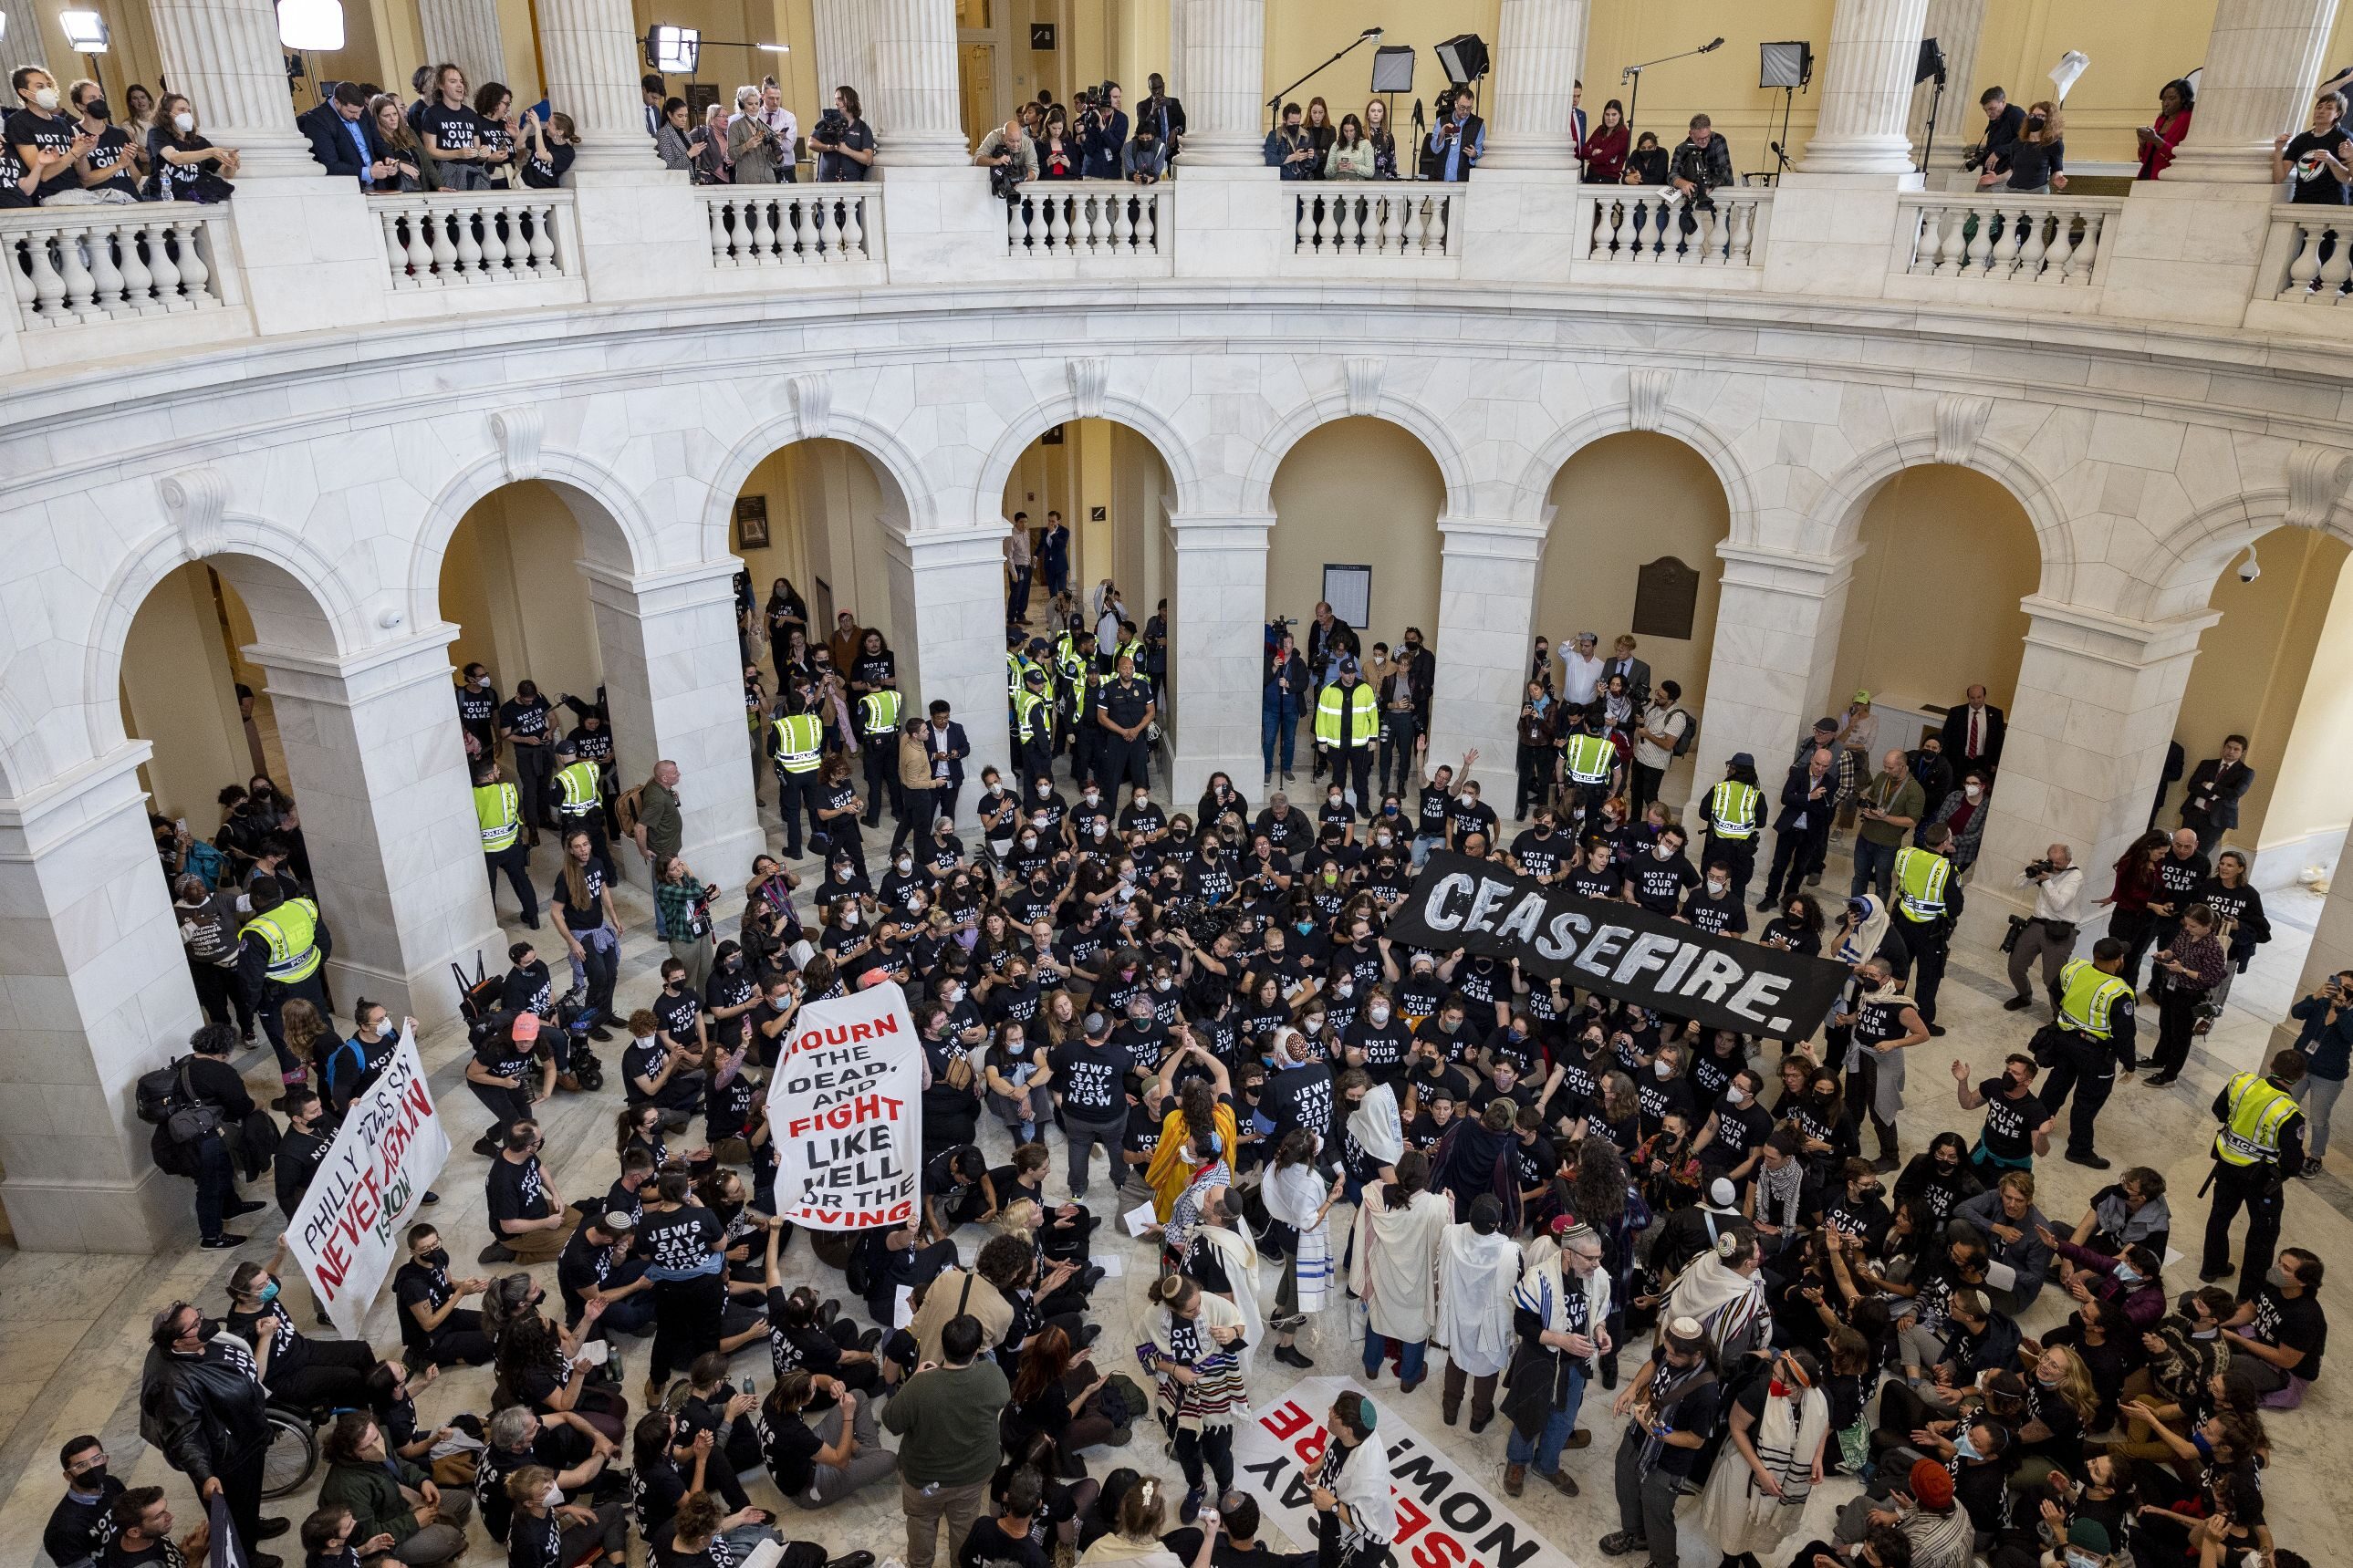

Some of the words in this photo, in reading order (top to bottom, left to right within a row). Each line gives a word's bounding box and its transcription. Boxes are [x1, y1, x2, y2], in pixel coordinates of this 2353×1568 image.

[35, 134, 59, 142] NOT
[448, 130, 472, 139] OUR
[517, 712, 532, 721] NOT
[835, 797, 852, 808] OUR
[1423, 808, 1443, 817] NAME
[1718, 821, 1745, 830] POLICE
[1526, 859, 1548, 868] OUR
[1206, 879, 1226, 887] OUR
[1648, 879, 1671, 887] OUR
[2162, 873, 2189, 884] OUR
[1202, 885, 1232, 894] NAME
[1577, 881, 1596, 889] NOT
[1643, 886, 1674, 895] NAME
[2207, 895, 2230, 904] NOT
[2210, 903, 2239, 915] OUR
[1699, 917, 1722, 927] OUR
[1074, 942, 1091, 951] NOT
[1425, 872, 1792, 1032] CEASEFIRE.
[992, 950, 1006, 960] NOT
[1461, 985, 1493, 1002] NAME
[1468, 982, 1489, 993] OUR
[1408, 1002, 1431, 1010] OUR
[1531, 999, 1551, 1011] OUR
[669, 1005, 687, 1020] NOT
[1013, 1006, 1035, 1018] OUR
[1158, 1007, 1174, 1020] OUR
[1875, 1010, 1886, 1018] IN
[1328, 1015, 1351, 1024] OUR
[1858, 1012, 1879, 1026] OUR
[809, 1045, 871, 1068] THE
[1136, 1048, 1158, 1058] OUR
[369, 1052, 391, 1069] NOT
[1699, 1058, 1716, 1072] NOT
[1070, 1062, 1112, 1075] JEWS
[1568, 1065, 1587, 1077] NOT
[788, 1062, 898, 1094] DEAD,
[1074, 1073, 1105, 1084] SAY
[1570, 1076, 1595, 1090] OUR
[1294, 1079, 1331, 1101] JEWS
[1416, 1081, 1434, 1094] NOT
[1641, 1085, 1658, 1099] NOT
[813, 1079, 876, 1109] AND
[1068, 1092, 1111, 1106] NOW
[1301, 1092, 1329, 1111] SAY
[1990, 1097, 2008, 1113] NOT
[2010, 1112, 2023, 1123] IN
[789, 1096, 903, 1138] FIGHT
[1589, 1115, 1606, 1129] NOT
[1990, 1109, 2014, 1131] OUR
[1738, 1123, 1747, 1133] IN
[1820, 1126, 1832, 1135] IN
[311, 1139, 331, 1160] NOT
[807, 1124, 892, 1170] LIKE
[853, 1172, 914, 1207] THE
[305, 1146, 360, 1255] PHILLY
[375, 1210, 391, 1248] IS
[649, 1221, 701, 1241] JEWS
[1853, 1219, 1866, 1231] IN
[657, 1235, 695, 1252] SAY
[655, 1242, 705, 1260] CEASE
[2272, 1312, 2281, 1324] IN
